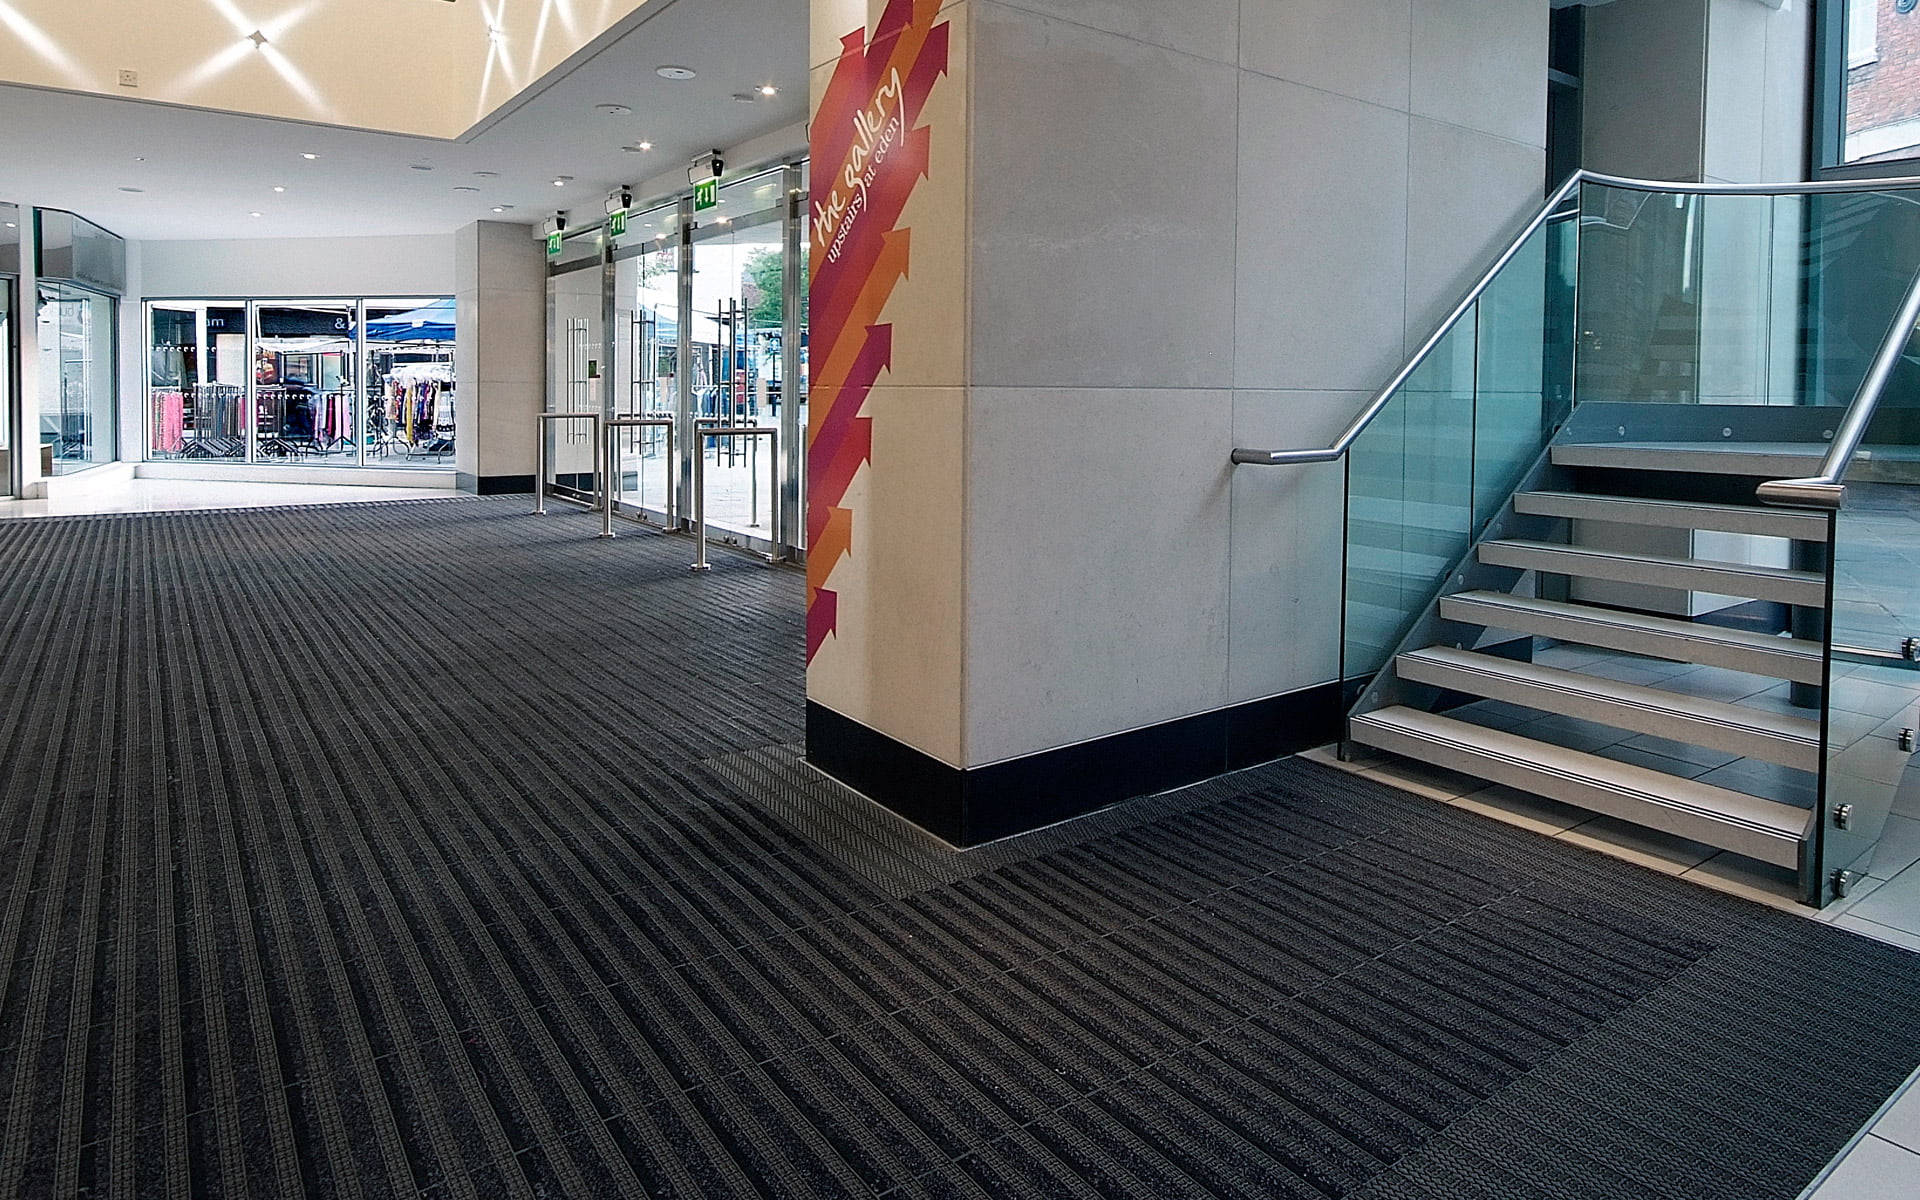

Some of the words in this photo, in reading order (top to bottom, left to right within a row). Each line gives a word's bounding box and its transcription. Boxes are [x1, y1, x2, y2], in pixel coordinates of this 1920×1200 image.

[813, 190, 846, 248] the
[844, 67, 904, 212] gallery
[827, 193, 864, 264] upstairs
[864, 165, 877, 188] at
[874, 117, 900, 164] eden
